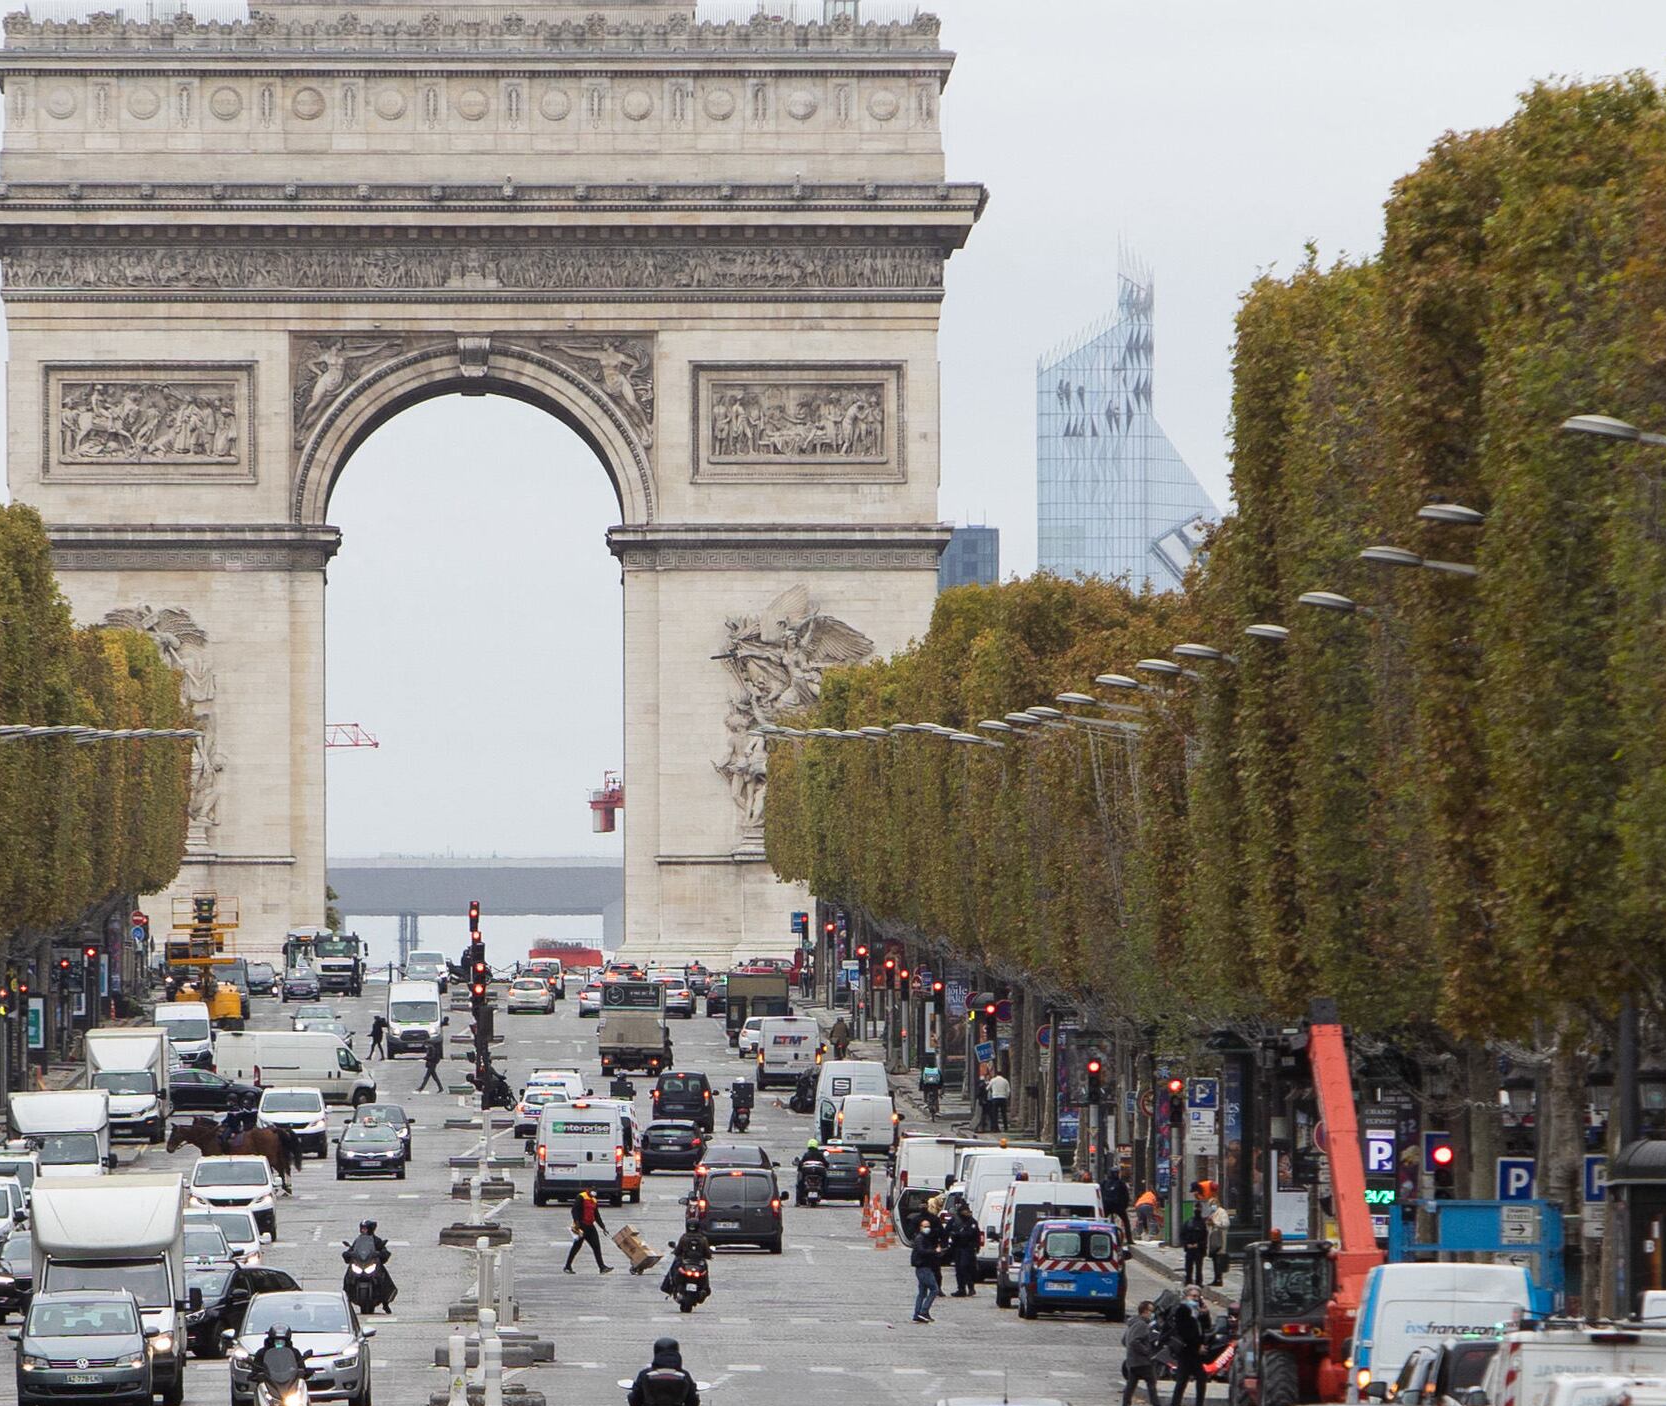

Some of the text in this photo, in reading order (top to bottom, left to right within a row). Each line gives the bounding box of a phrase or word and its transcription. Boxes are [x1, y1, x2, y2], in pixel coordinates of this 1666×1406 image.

[554, 1124, 611, 1134] enterprise
[1369, 1141, 1392, 1170] P
[1509, 1168, 1530, 1196] P
